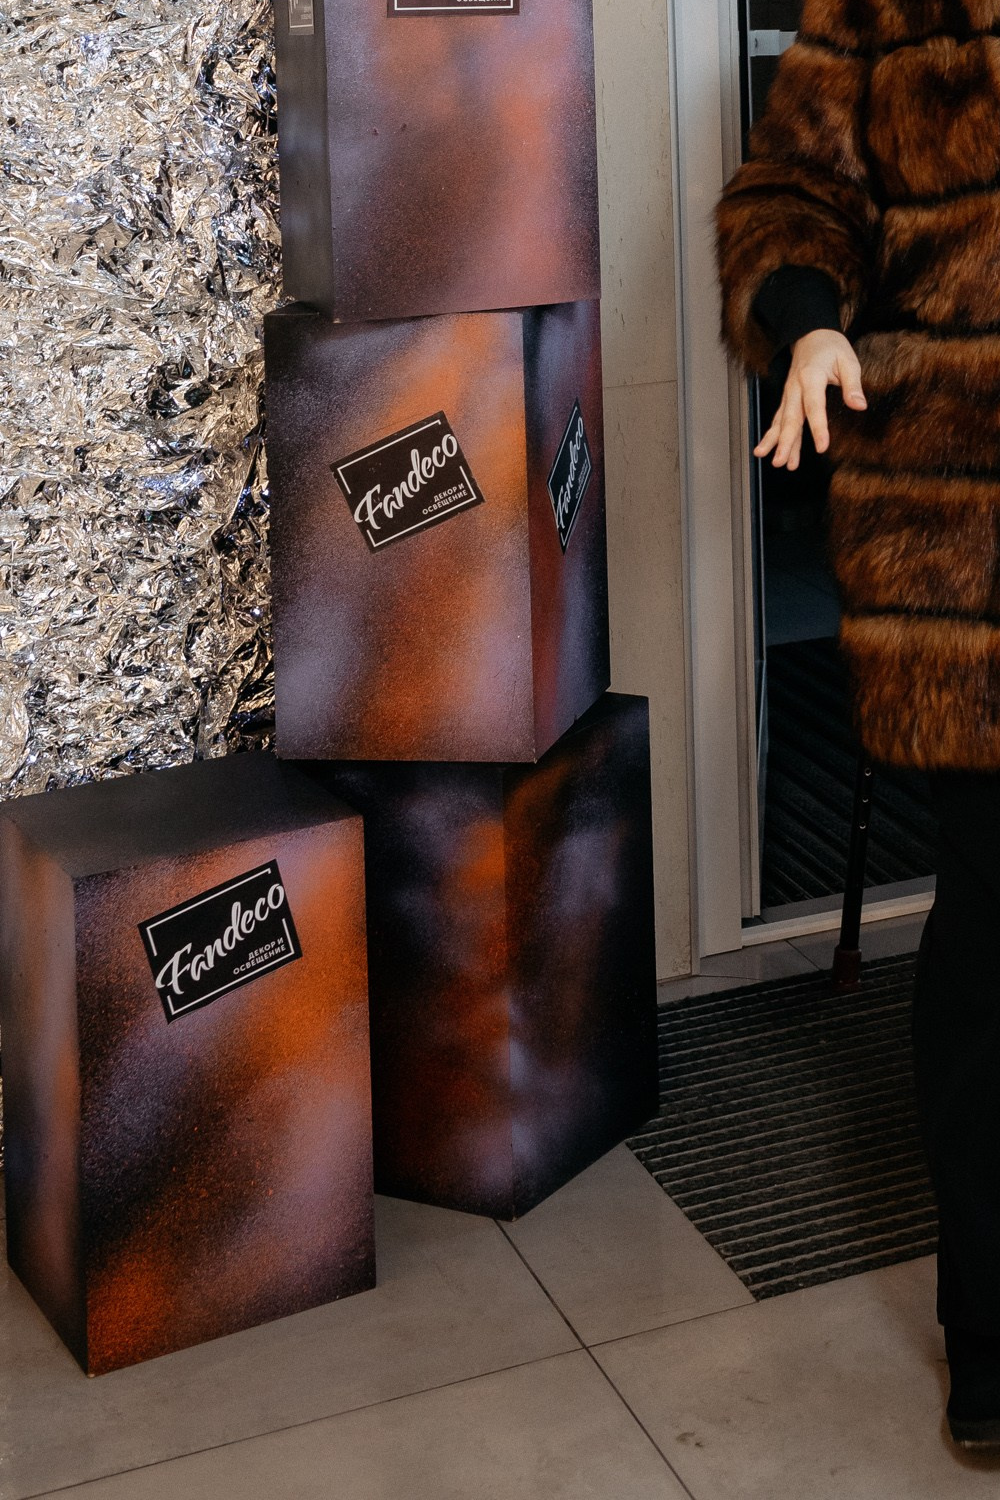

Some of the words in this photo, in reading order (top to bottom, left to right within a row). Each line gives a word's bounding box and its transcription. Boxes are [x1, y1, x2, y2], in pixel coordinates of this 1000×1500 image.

[354, 433, 458, 530] Fandeco
[557, 416, 584, 529] Fandeco
[422, 489, 468, 515] ОСВЕЩЕНИЕ
[433, 486, 458, 503] ДЕКОР
[458, 482, 465, 490] И
[155, 883, 285, 995] Fandeco
[248, 941, 277, 961] ДЕКОР
[277, 937, 284, 945] И
[233, 944, 287, 975] ОСВЕЩЕНИЕ
